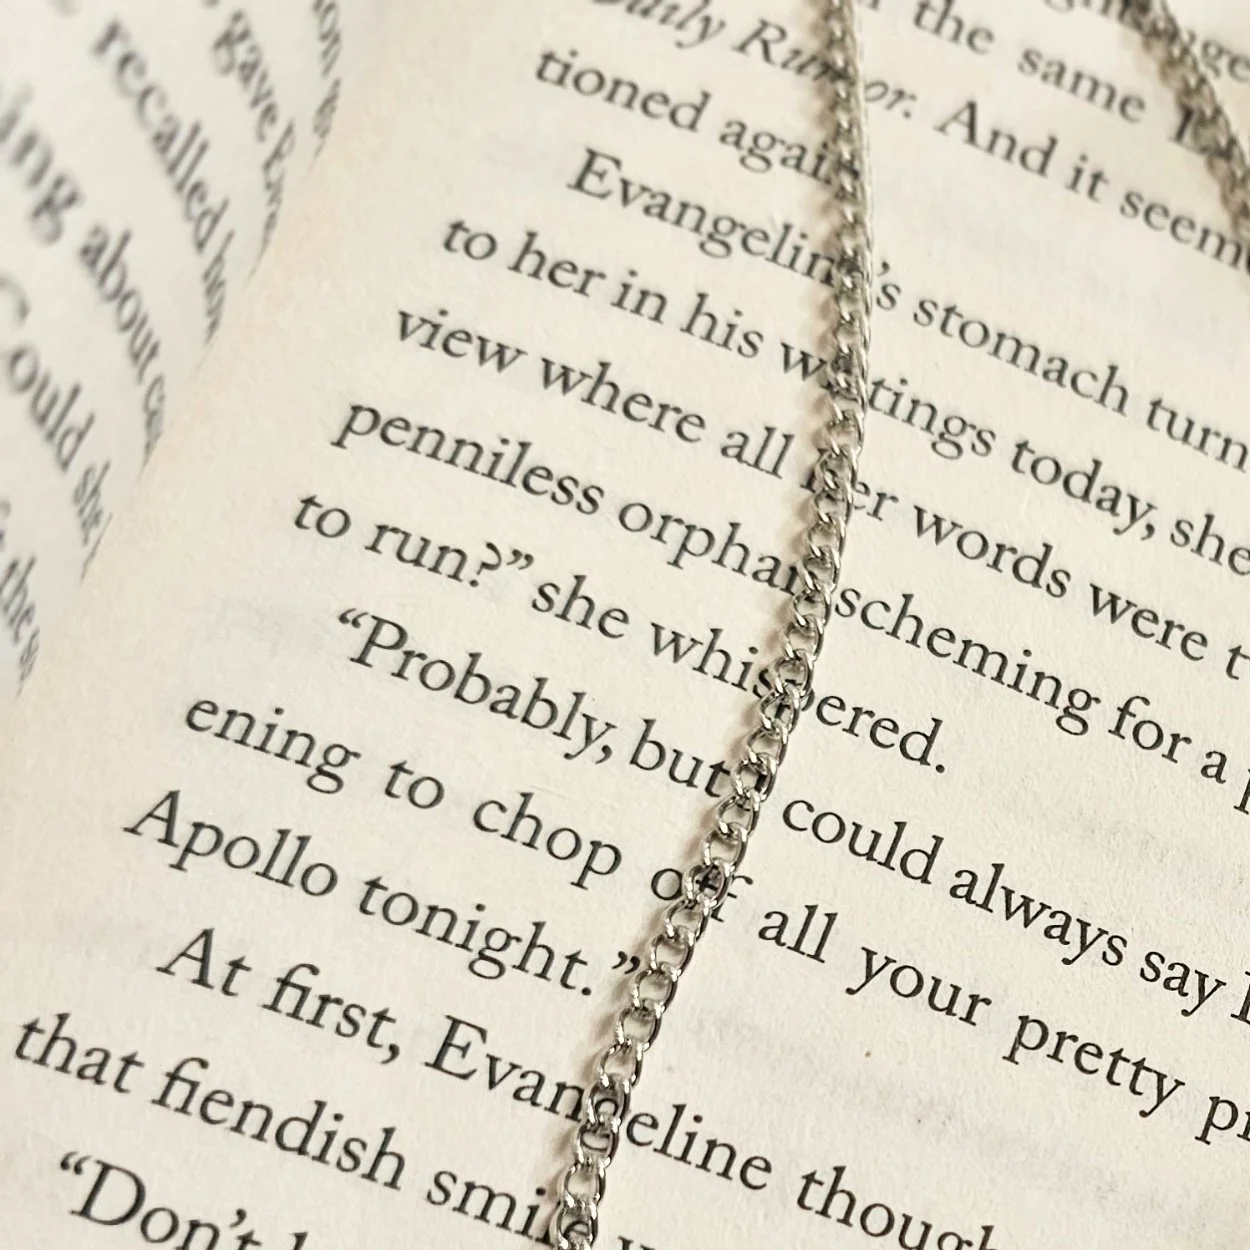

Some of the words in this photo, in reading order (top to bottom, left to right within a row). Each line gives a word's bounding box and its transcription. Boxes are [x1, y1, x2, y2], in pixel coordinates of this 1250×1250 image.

[535, 49, 712, 133] tioned
[912, 0, 997, 55] the
[1018, 48, 1145, 123] same
[934, 99, 1059, 178] And
[1065, 153, 1109, 202] it
[566, 148, 901, 311] Evangelin’s
[913, 298, 1129, 417] stomach
[442, 220, 498, 261] to
[507, 230, 607, 298] her
[610, 269, 668, 325] in
[679, 291, 764, 358] his
[1011, 439, 1157, 540] today,
[293, 493, 351, 540] to
[364, 524, 534, 587] run?”
[531, 575, 629, 639] she
[398, 308, 528, 374] view
[540, 357, 706, 443] where
[720, 425, 795, 479] all
[913, 505, 1071, 598] words
[1090, 583, 1208, 661] were
[330, 403, 604, 515] penniless
[836, 588, 1101, 736] scheming
[1108, 696, 1192, 764] for
[1200, 750, 1227, 784] a
[122, 790, 338, 897] Apollo
[337, 608, 617, 764] “Probably,
[629, 718, 731, 798] but
[782, 800, 944, 885] could
[949, 863, 1127, 966] always
[1140, 951, 1227, 1017] say
[155, 928, 252, 996] At
[261, 963, 400, 1064] first,
[185, 700, 362, 794] ening
[384, 760, 445, 809] to
[472, 792, 622, 890] chop
[758, 904, 838, 964] all
[845, 947, 992, 1026] your
[1002, 1015, 1185, 1118] pretty
[15, 1013, 144, 1094] that
[150, 1057, 405, 1191] fiendish
